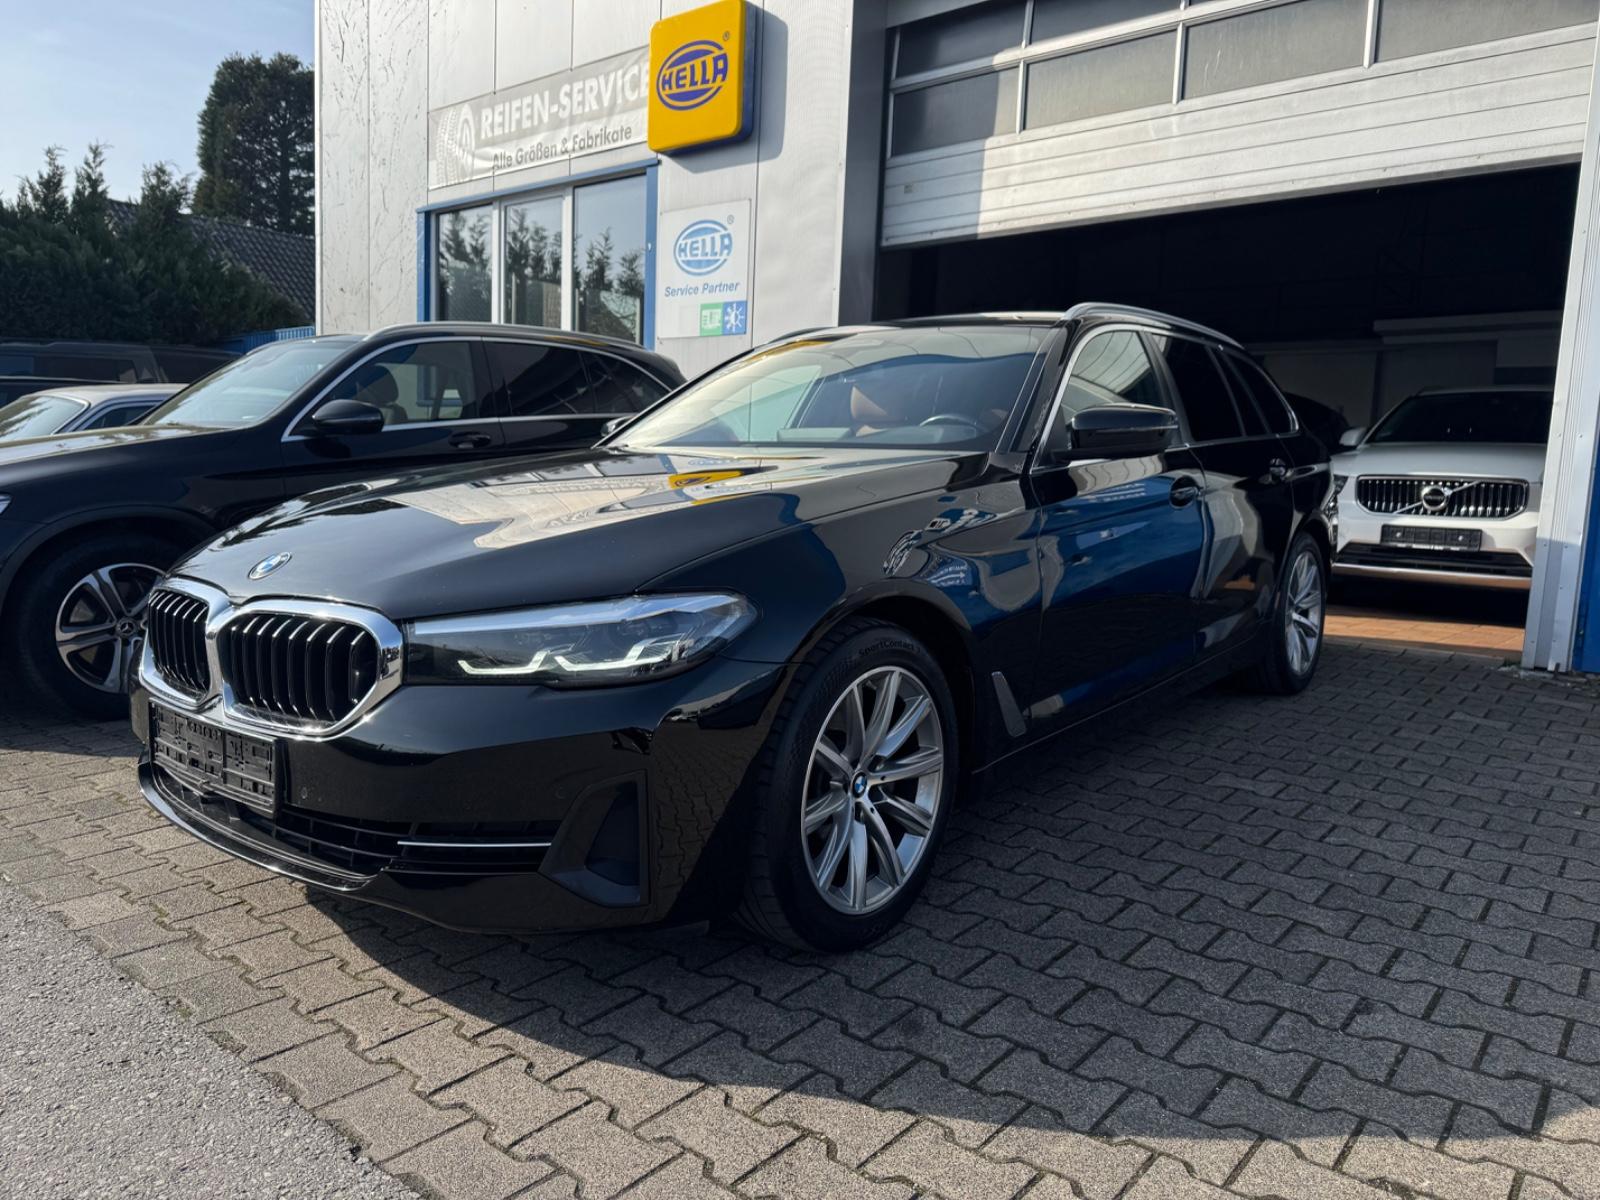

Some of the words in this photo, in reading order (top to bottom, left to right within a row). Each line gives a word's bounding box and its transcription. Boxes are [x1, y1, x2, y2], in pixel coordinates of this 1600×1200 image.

[661, 52, 728, 91] HELLA
[492, 151, 513, 170] Alle
[515, 142, 557, 165] Größen
[560, 137, 569, 155] &
[572, 125, 632, 152] Fabrikate
[678, 232, 733, 258] HELLA
[664, 284, 699, 297] Service
[702, 282, 740, 294] Partner
